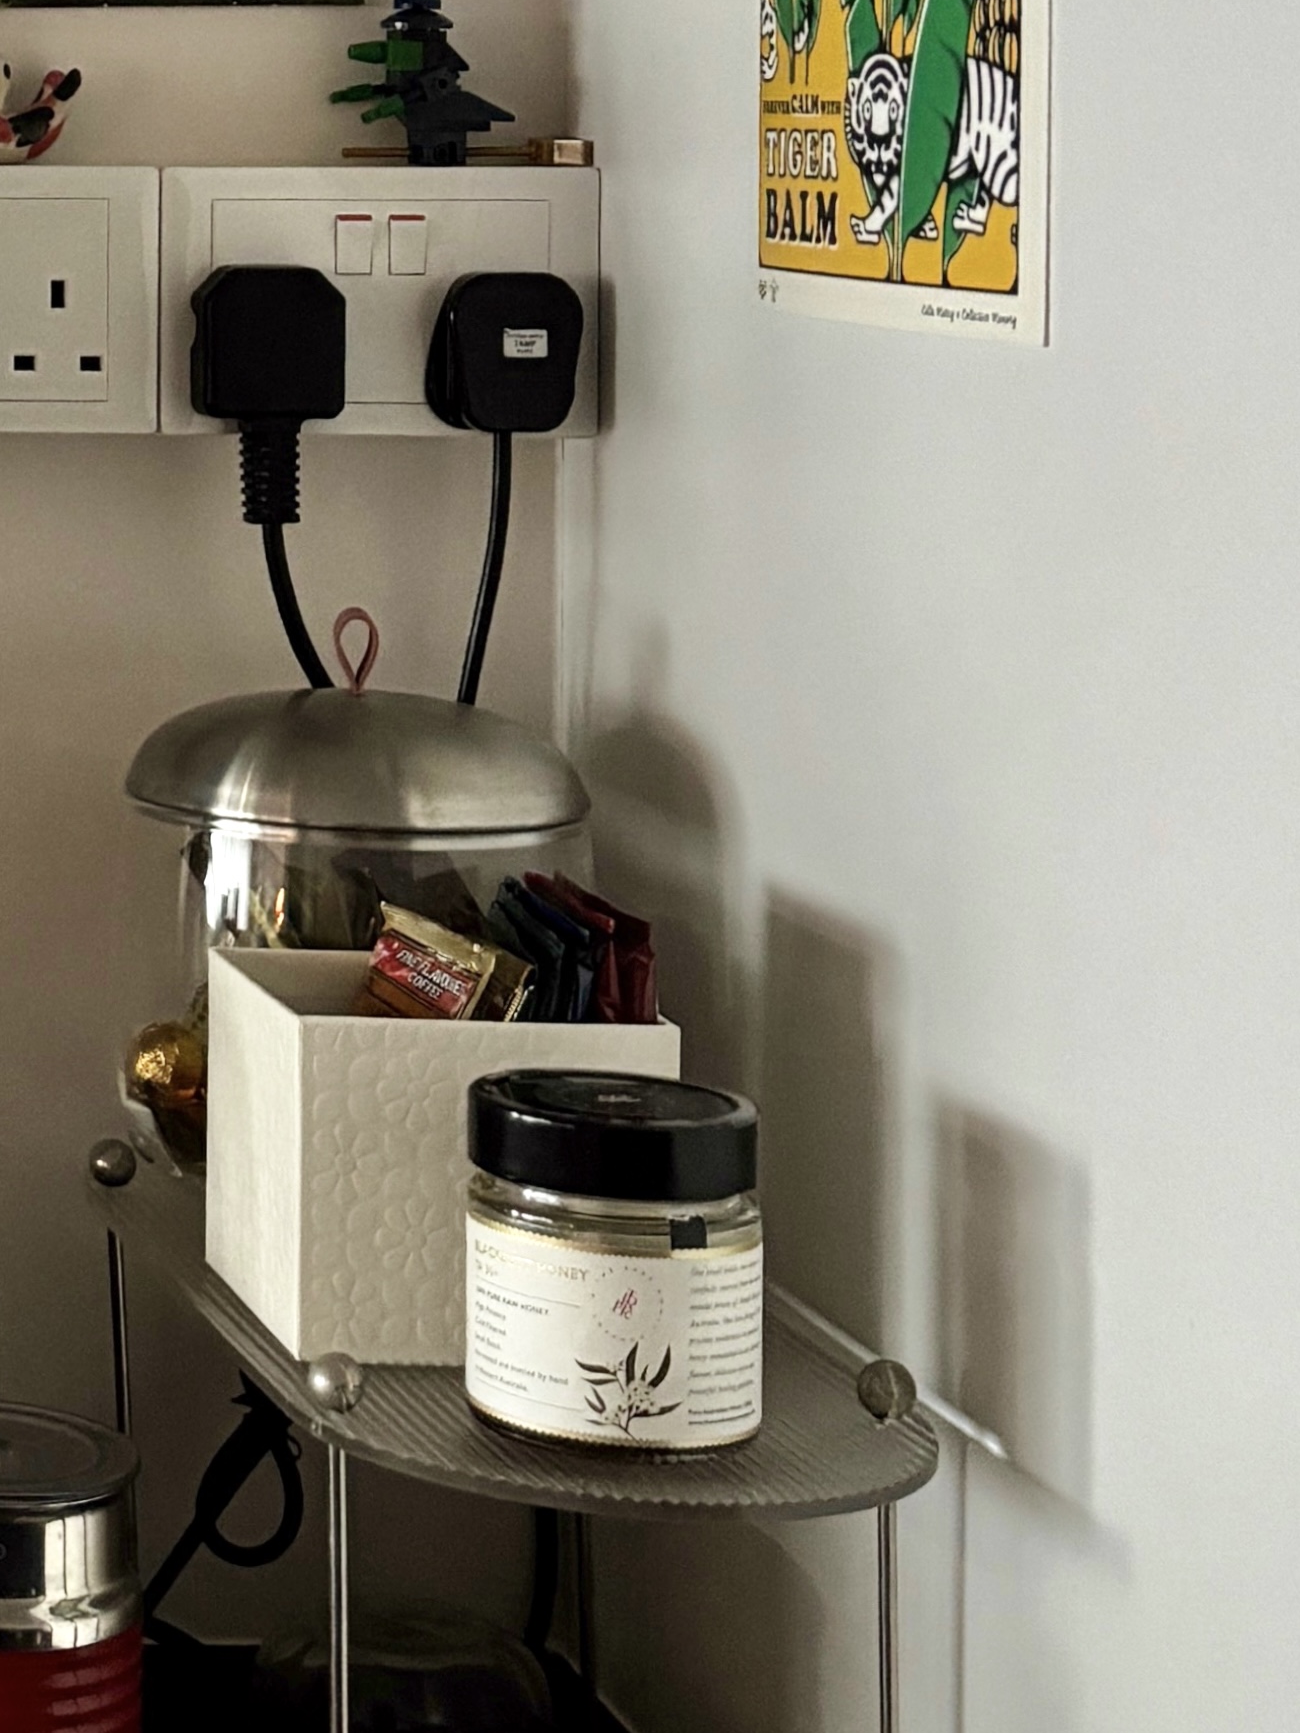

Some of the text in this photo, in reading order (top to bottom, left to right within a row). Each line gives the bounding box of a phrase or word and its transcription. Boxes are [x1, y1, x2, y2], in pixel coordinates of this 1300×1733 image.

[791, 93, 819, 114] CALM
[820, 100, 841, 115] WITH
[765, 128, 839, 181] TIGER
[766, 188, 839, 248] BALM
[406, 971, 444, 1000] COFFEE
